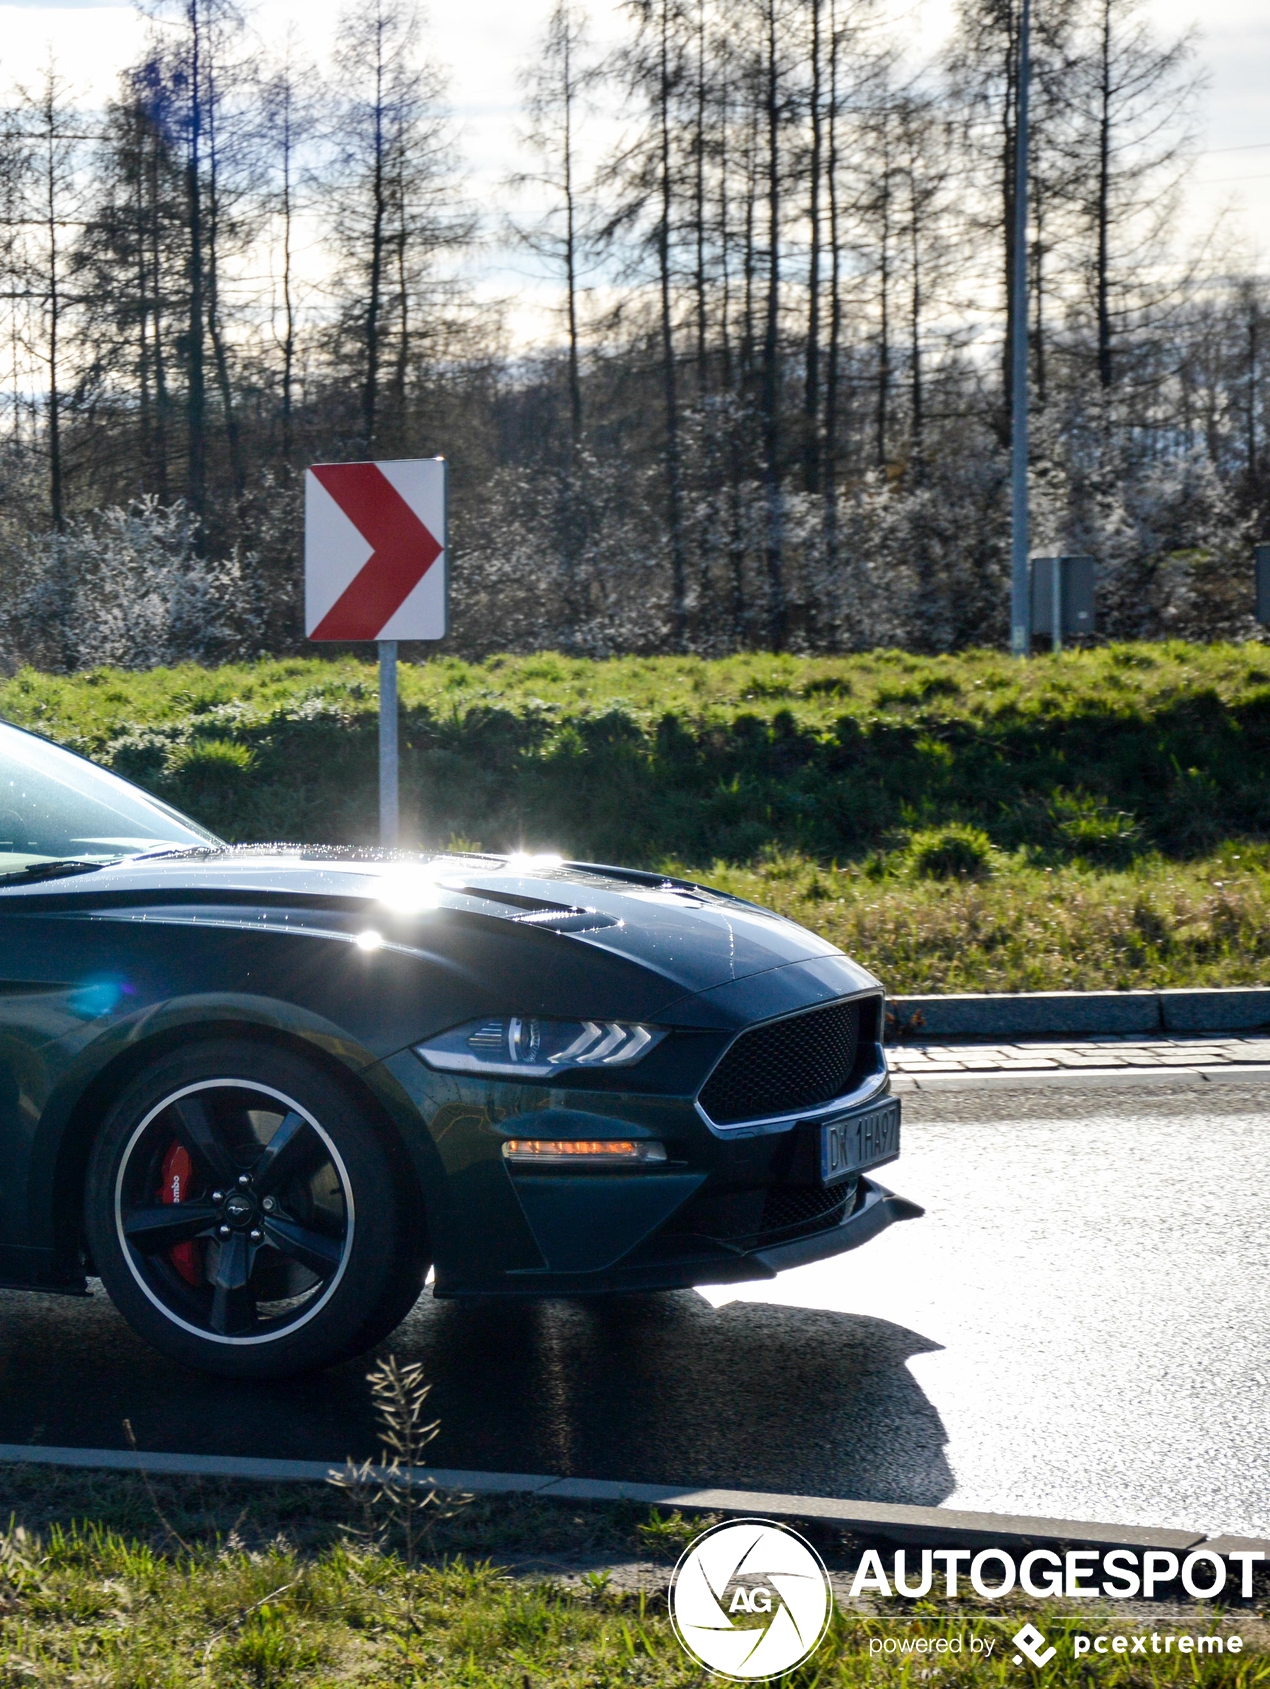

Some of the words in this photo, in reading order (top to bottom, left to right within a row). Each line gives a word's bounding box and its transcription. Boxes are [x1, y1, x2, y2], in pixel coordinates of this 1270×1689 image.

[830, 1123, 849, 1171] DK
[856, 1106, 896, 1161] 1HA97
[171, 1175, 180, 1203] embo
